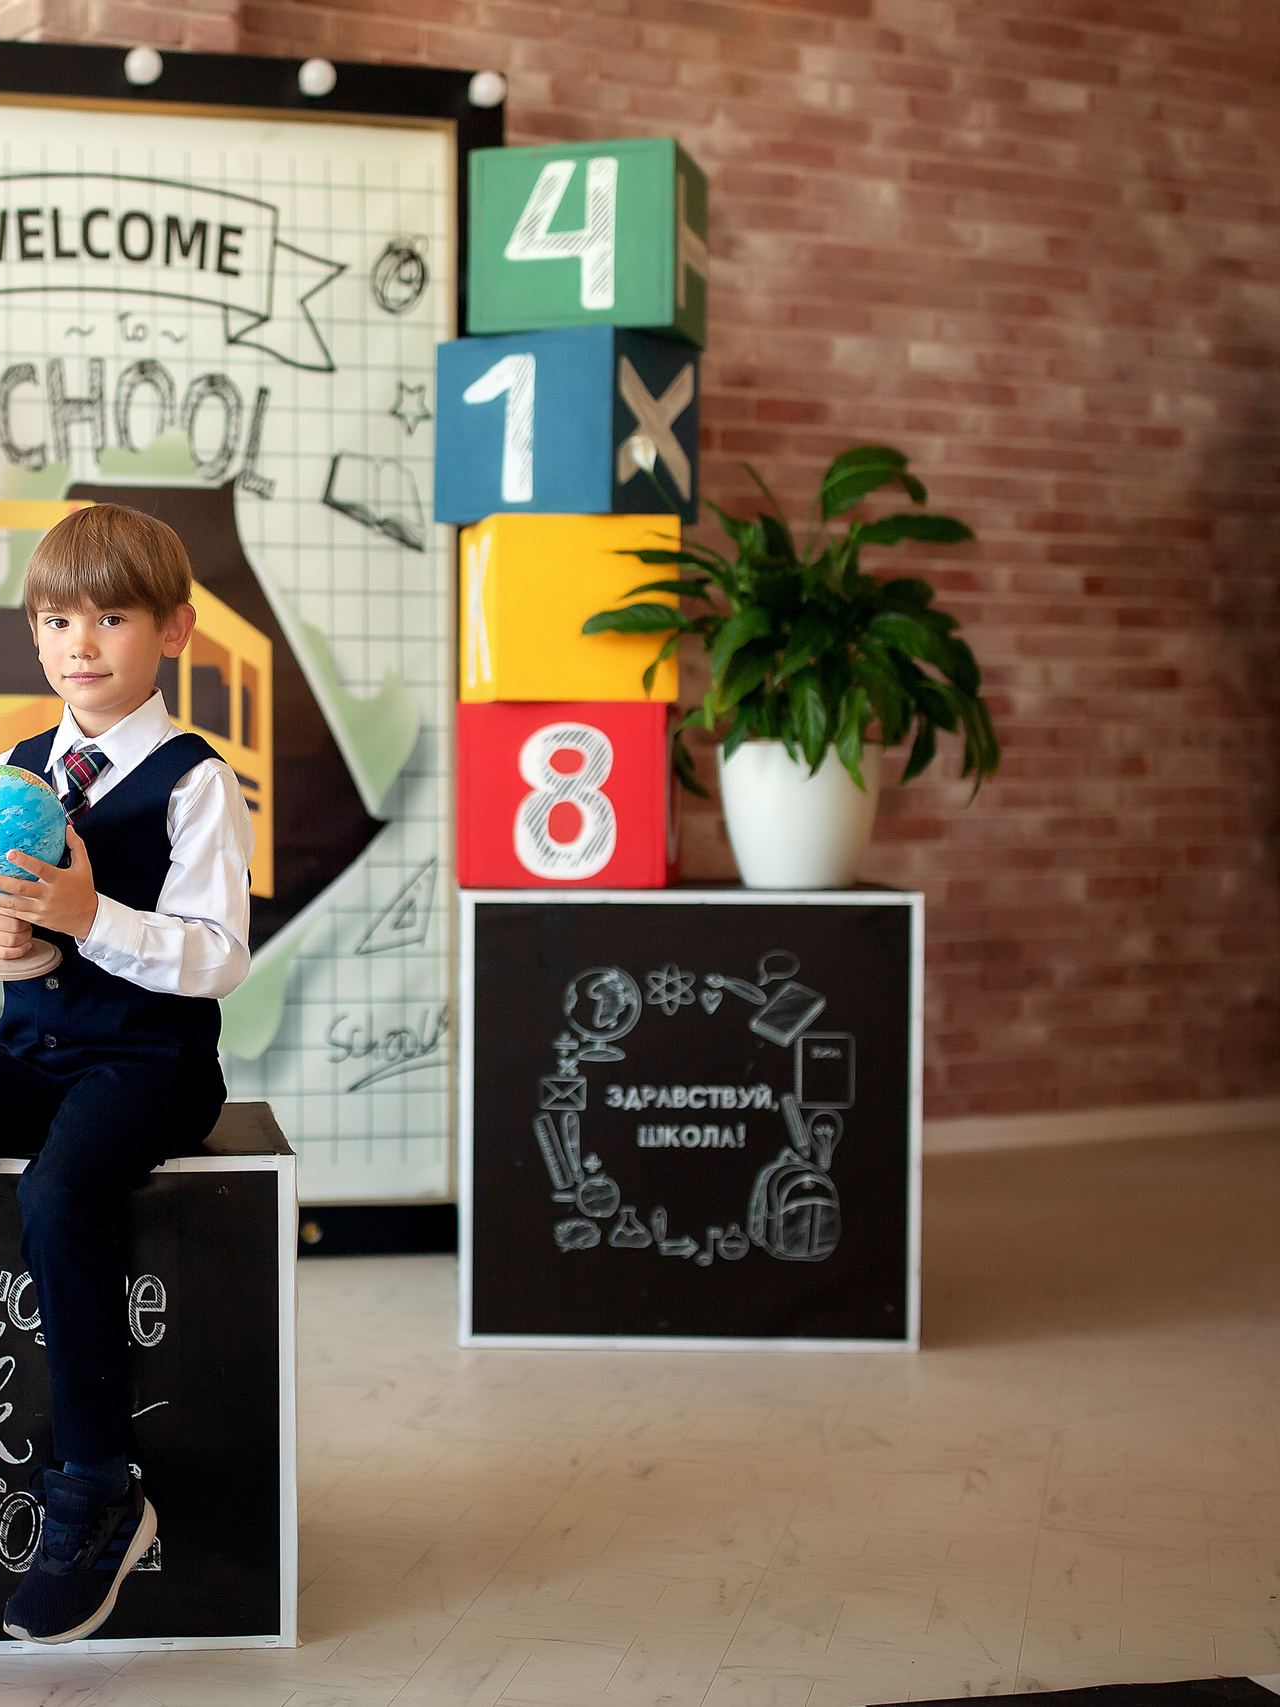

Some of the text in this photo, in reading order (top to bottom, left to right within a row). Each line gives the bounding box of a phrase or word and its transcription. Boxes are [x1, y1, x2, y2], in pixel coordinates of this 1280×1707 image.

[505, 156, 618, 309] 4
[462, 353, 536, 502] 1
[513, 721, 618, 881] 8
[604, 1082, 780, 1113] ЗДРАВСТВУЙ,
[636, 1122, 747, 1148] ШКОЛА!
